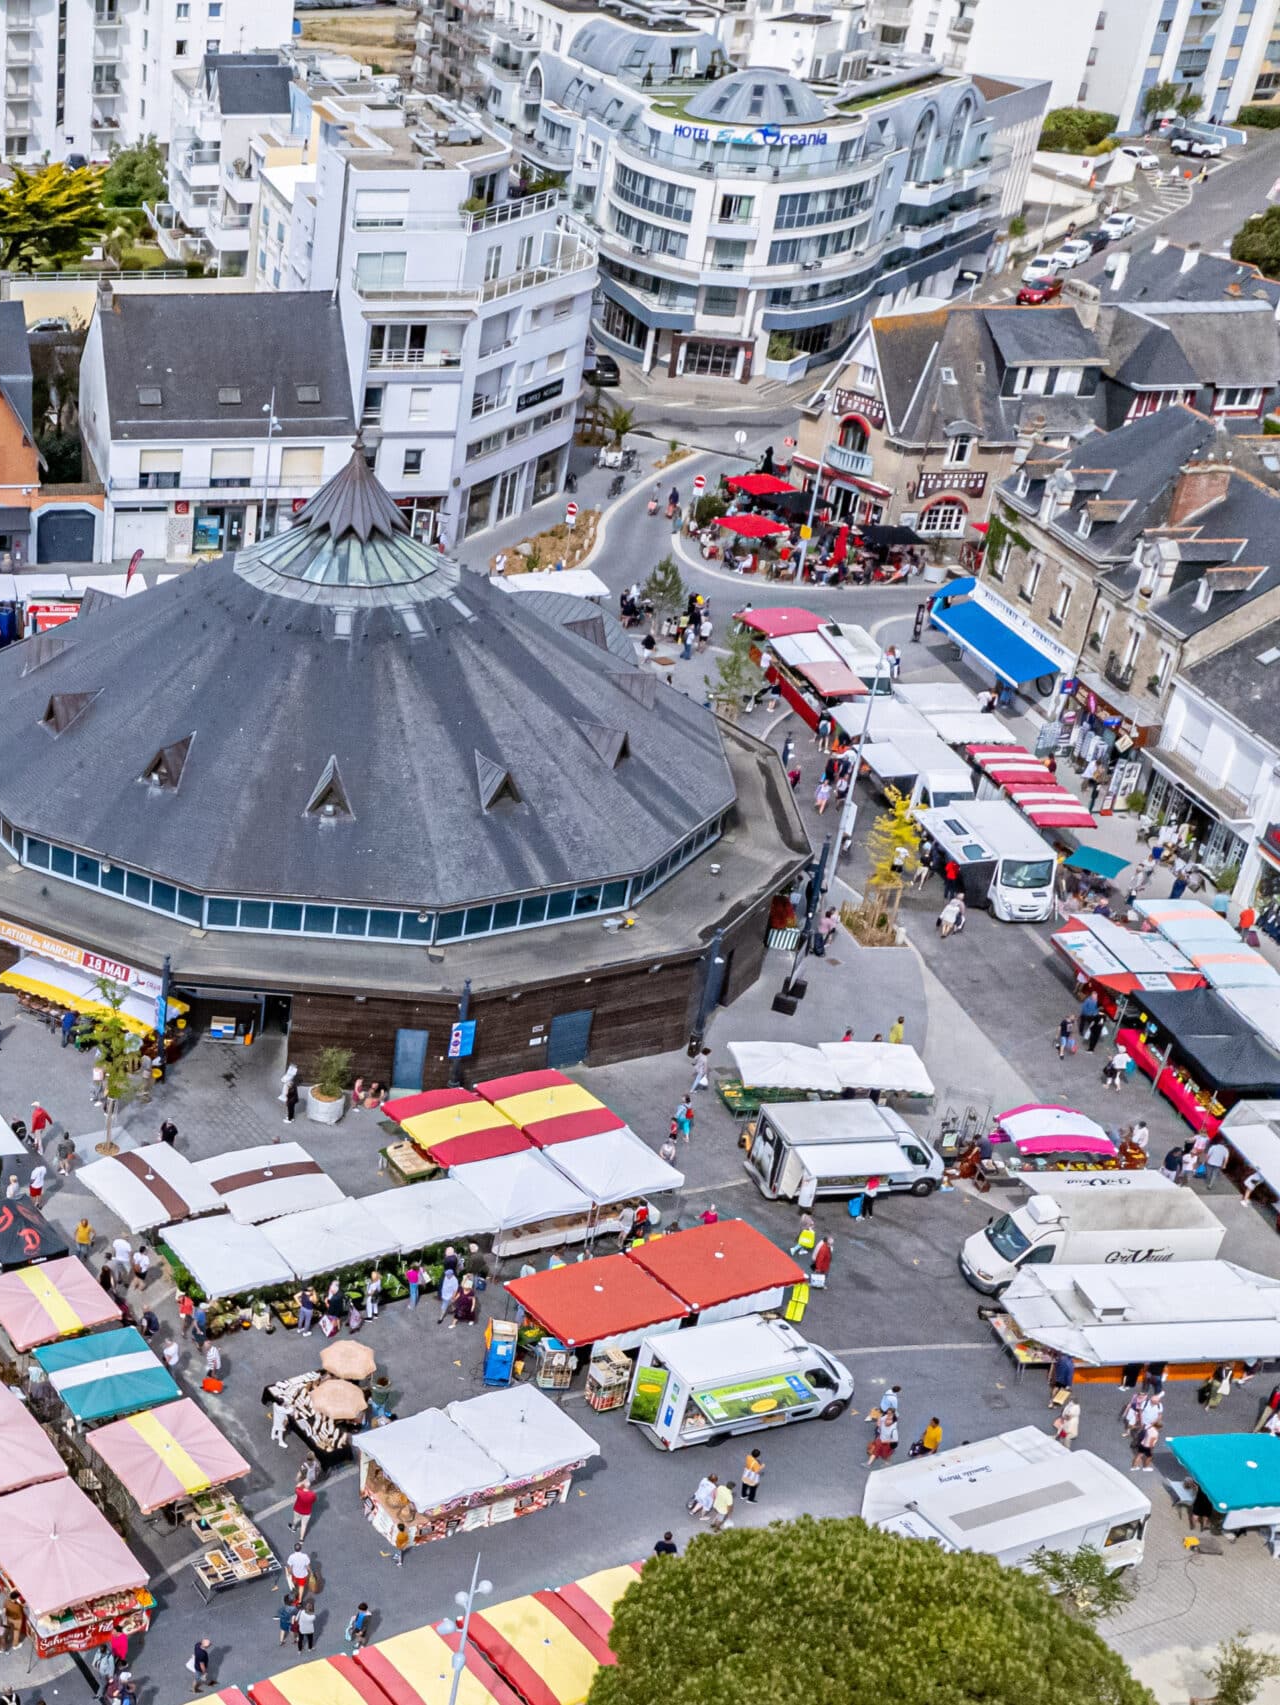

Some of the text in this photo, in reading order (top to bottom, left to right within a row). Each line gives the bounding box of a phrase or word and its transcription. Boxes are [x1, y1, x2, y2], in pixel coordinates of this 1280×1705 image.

[673, 124, 711, 141] HOTEL
[87, 956, 127, 980] 18 MAI
